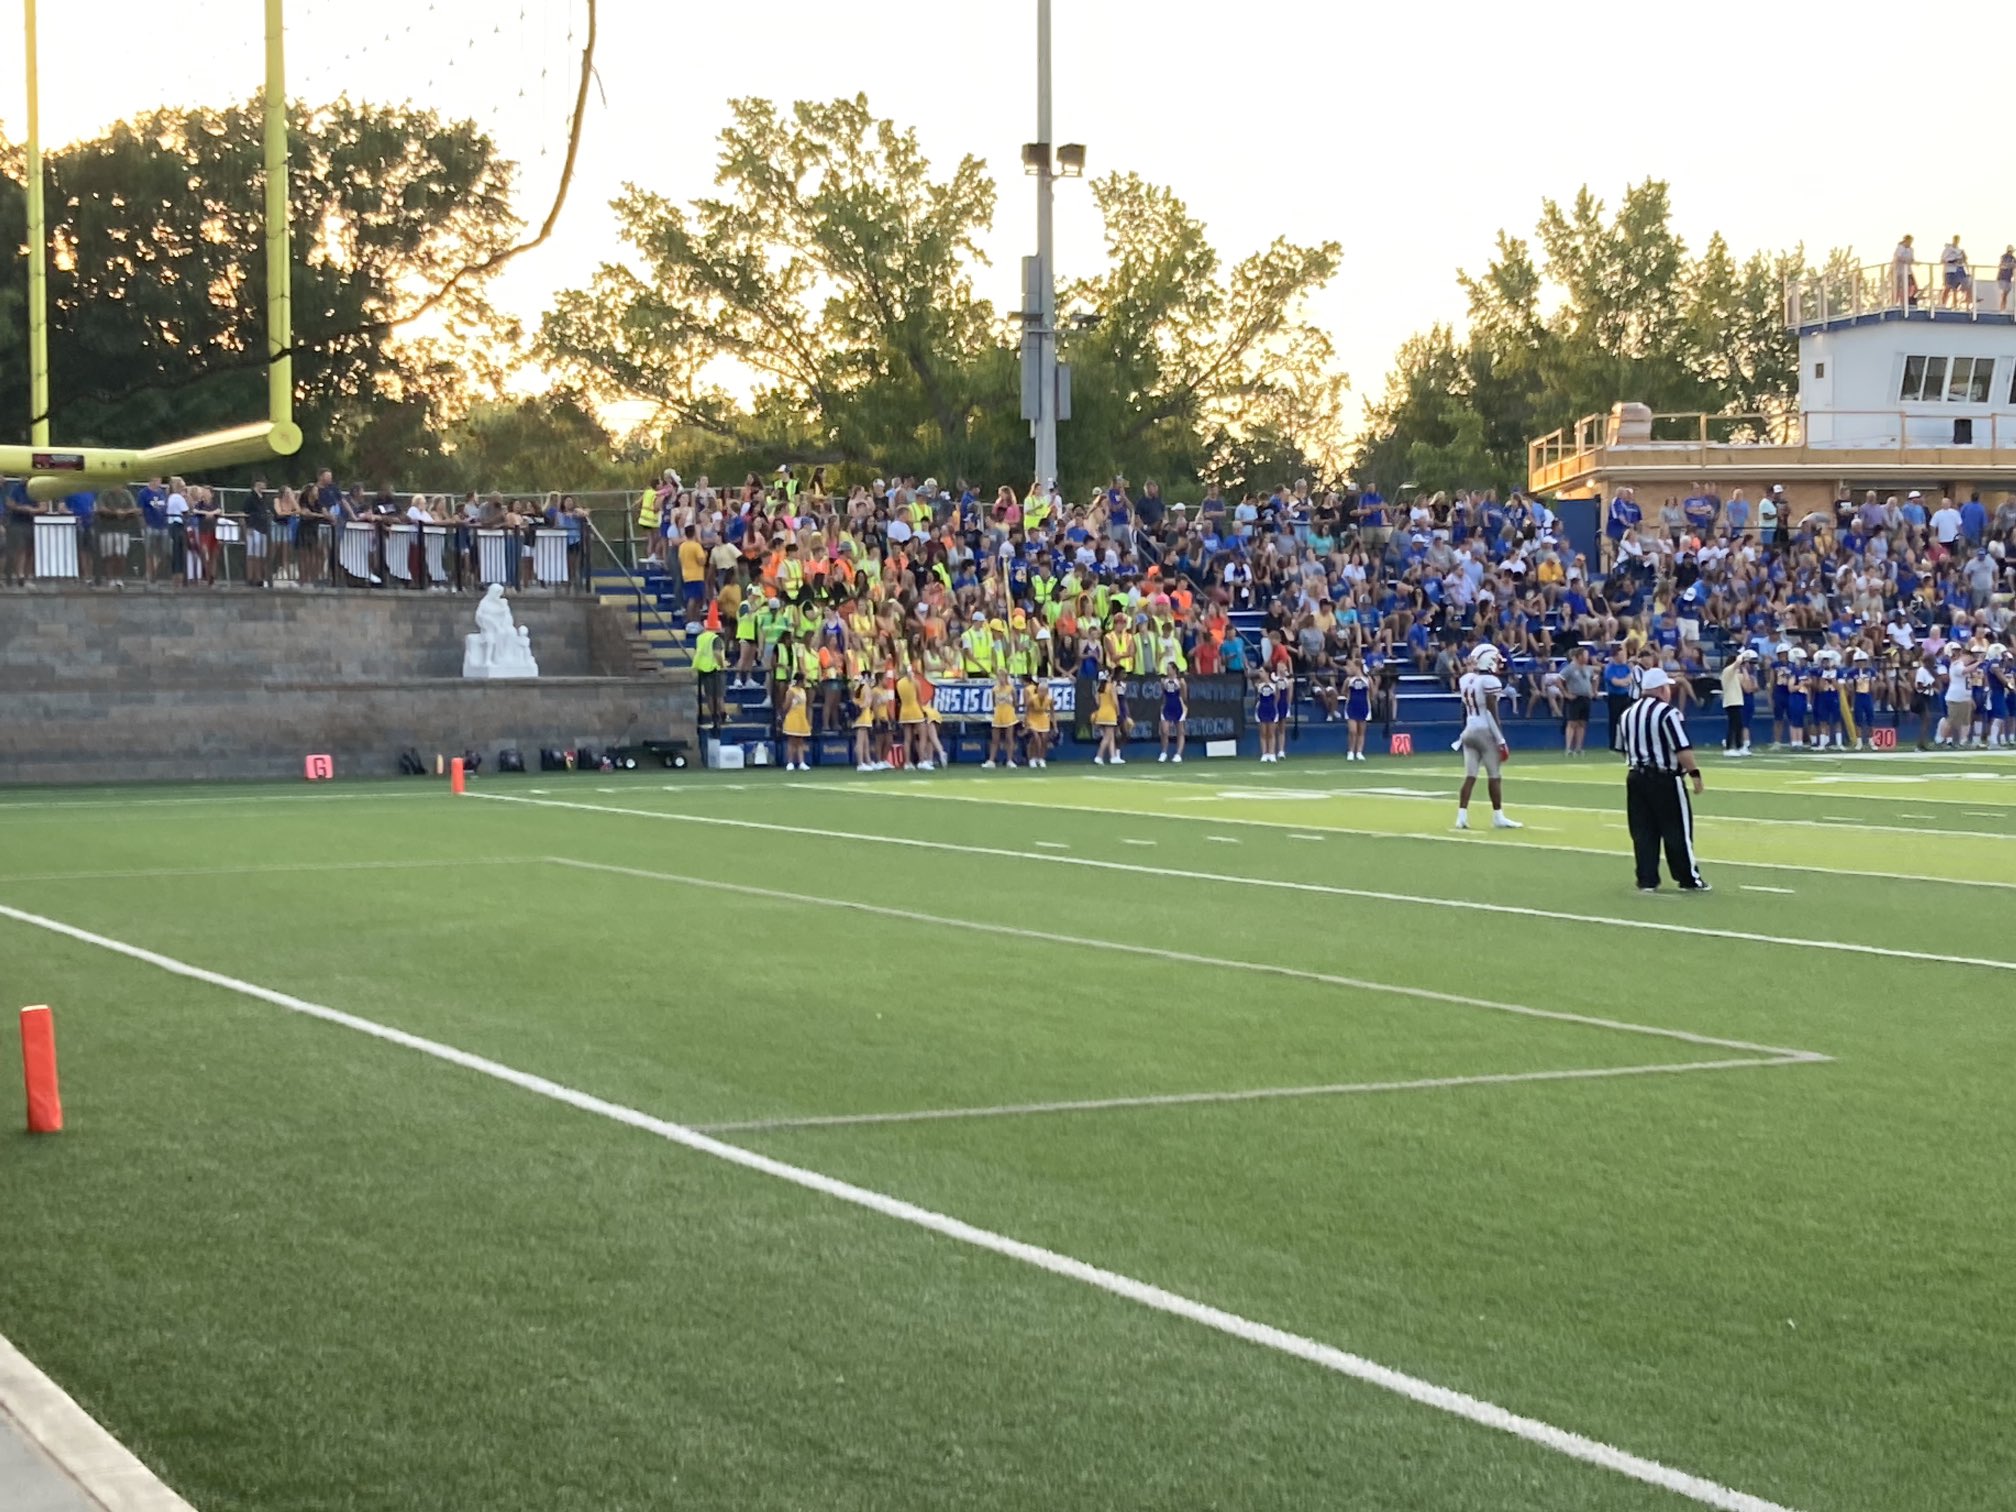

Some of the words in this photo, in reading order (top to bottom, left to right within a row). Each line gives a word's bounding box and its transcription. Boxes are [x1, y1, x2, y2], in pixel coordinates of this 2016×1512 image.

[933, 688, 961, 712] HIS
[963, 688, 980, 712] IS
[1464, 688, 1480, 716] 11
[1874, 730, 1893, 747] 30
[313, 757, 327, 778] G
